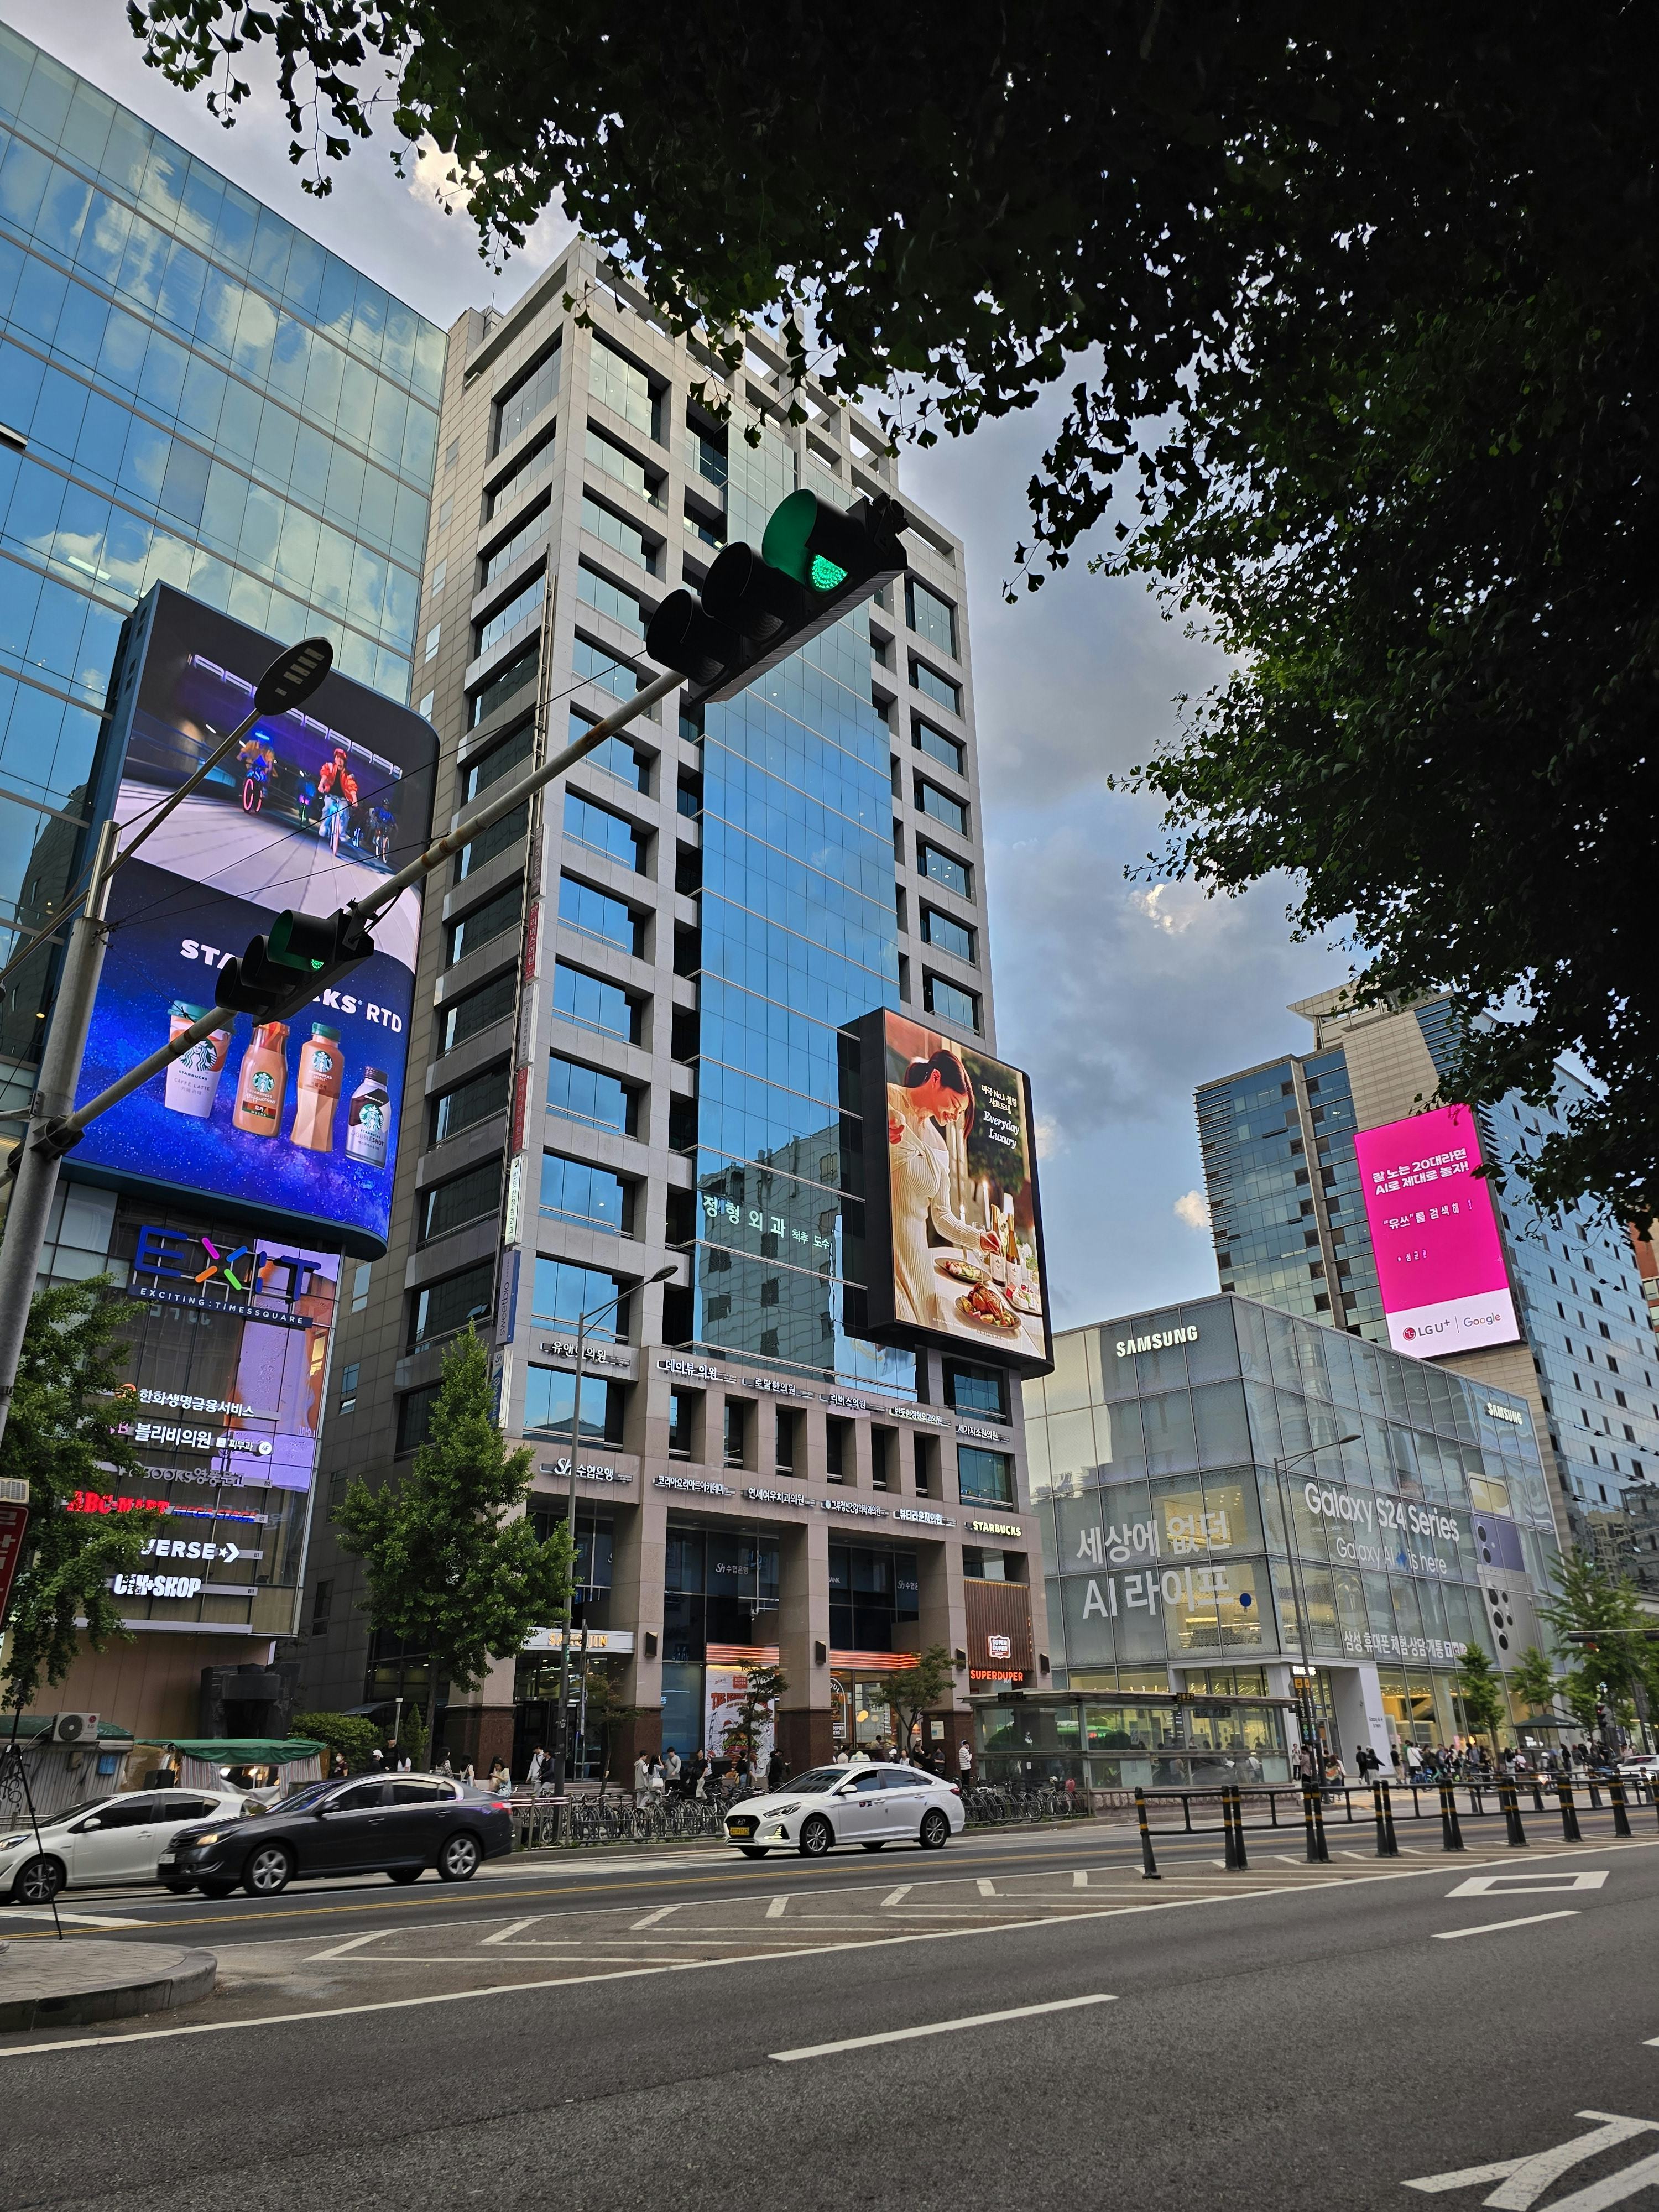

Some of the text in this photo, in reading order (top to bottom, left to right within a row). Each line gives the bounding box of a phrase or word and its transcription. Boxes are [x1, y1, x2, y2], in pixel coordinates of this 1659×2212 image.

[366, 1001, 402, 1032] RTD
[982, 1085, 993, 1097] 미국
[983, 1110, 1020, 1136] Everyday
[988, 1128, 1017, 1150] Luxury
[1387, 1165, 1411, 1180] 노는
[1412, 1148, 1467, 1172] 20대라면
[1375, 1161, 1469, 1196] AI로 제대로 놀자!
[703, 1196, 830, 1250] 정형외과 척추 도수
[499, 1281, 509, 1337] sweetbio
[1418, 1326, 1433, 1337] LG
[1463, 1312, 1501, 1327] Google
[1116, 1326, 1198, 1357] SAMSUNG
[665, 1358, 695, 1376] 데이뷰
[698, 1364, 717, 1380] 의원
[754, 1377, 796, 1395] 로담한의원
[139, 1388, 255, 1417] 한화생명금융서비스
[830, 1393, 866, 1410] 리버스의원
[1487, 1402, 1522, 1425] SAMSUNG
[135, 1422, 212, 1449] 블리비의원
[228, 1439, 253, 1452] 피부과
[576, 1464, 614, 1482] 수협은행
[658, 1475, 724, 1495] 코리아요리아트아카데미
[748, 1487, 804, 1506] 연세여우치과의원
[1305, 1482, 1460, 1542] Galaxy S24 Series
[973, 1521, 1022, 1537] STARBUCKS
[1076, 1510, 1230, 1564] 세상에 없던
[1336, 1537, 1447, 1575] Galaxy AI is here
[1082, 1566, 1234, 1619] AI 라이프
[1344, 1631, 1362, 1653] 삼성
[1363, 1632, 1391, 1655] 휴대폰
[971, 1670, 1023, 1681] SUPERDUPER
